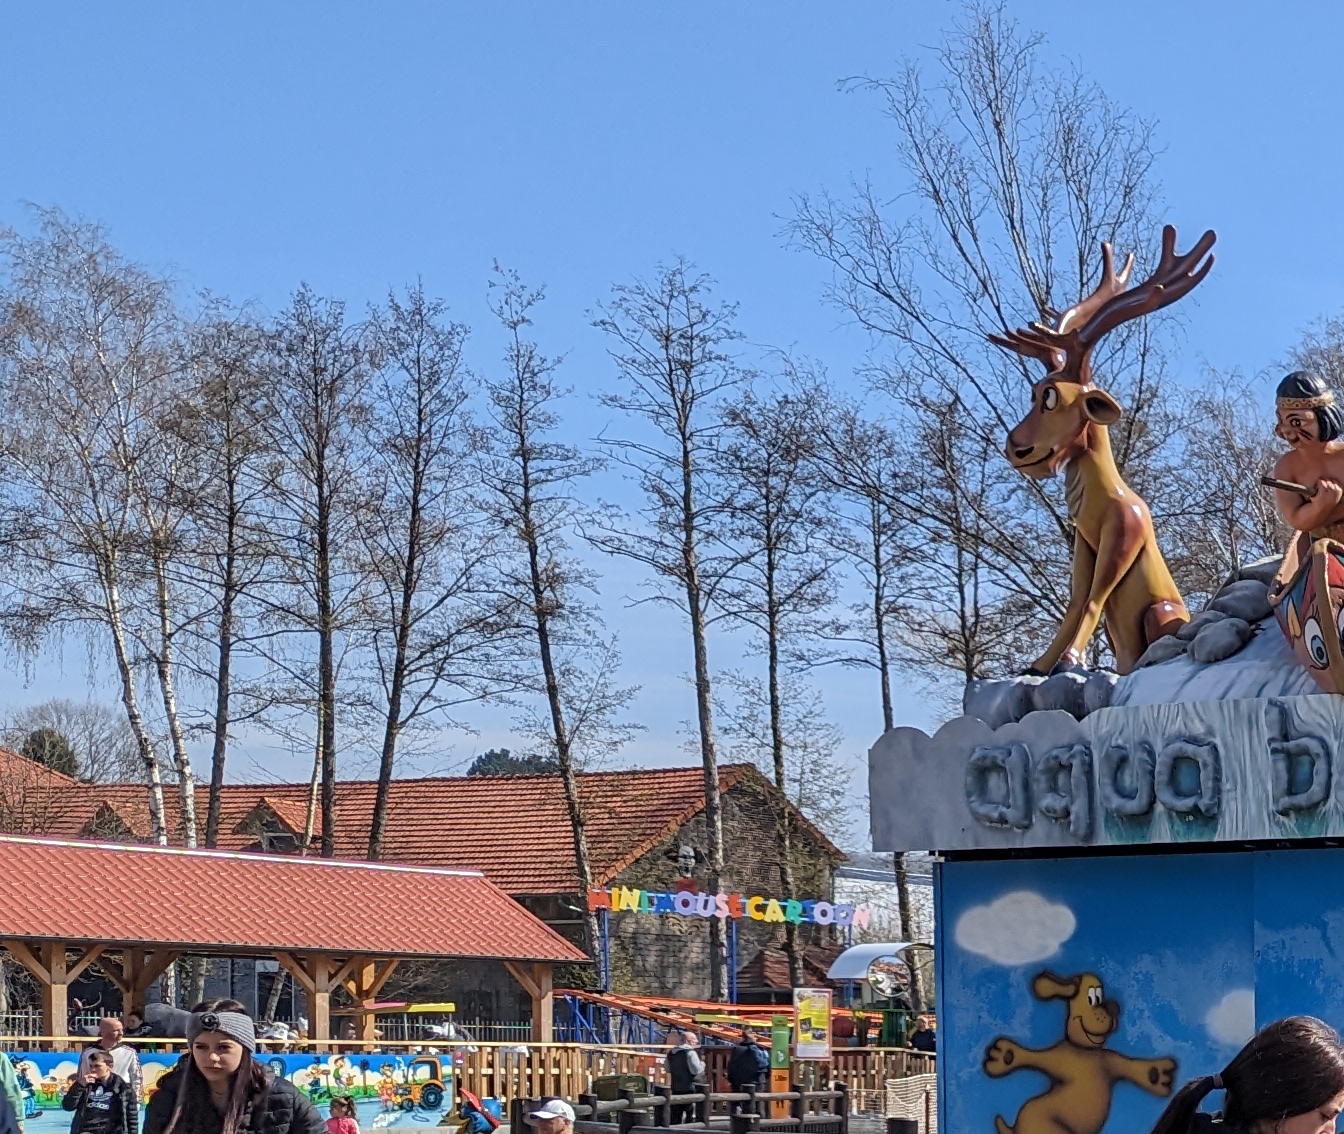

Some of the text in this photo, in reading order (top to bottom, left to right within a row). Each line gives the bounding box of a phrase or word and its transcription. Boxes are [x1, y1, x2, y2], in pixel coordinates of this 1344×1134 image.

[966, 740, 1223, 841] aqua
[588, 885, 870, 930] MINI MOUSE CARTOON
